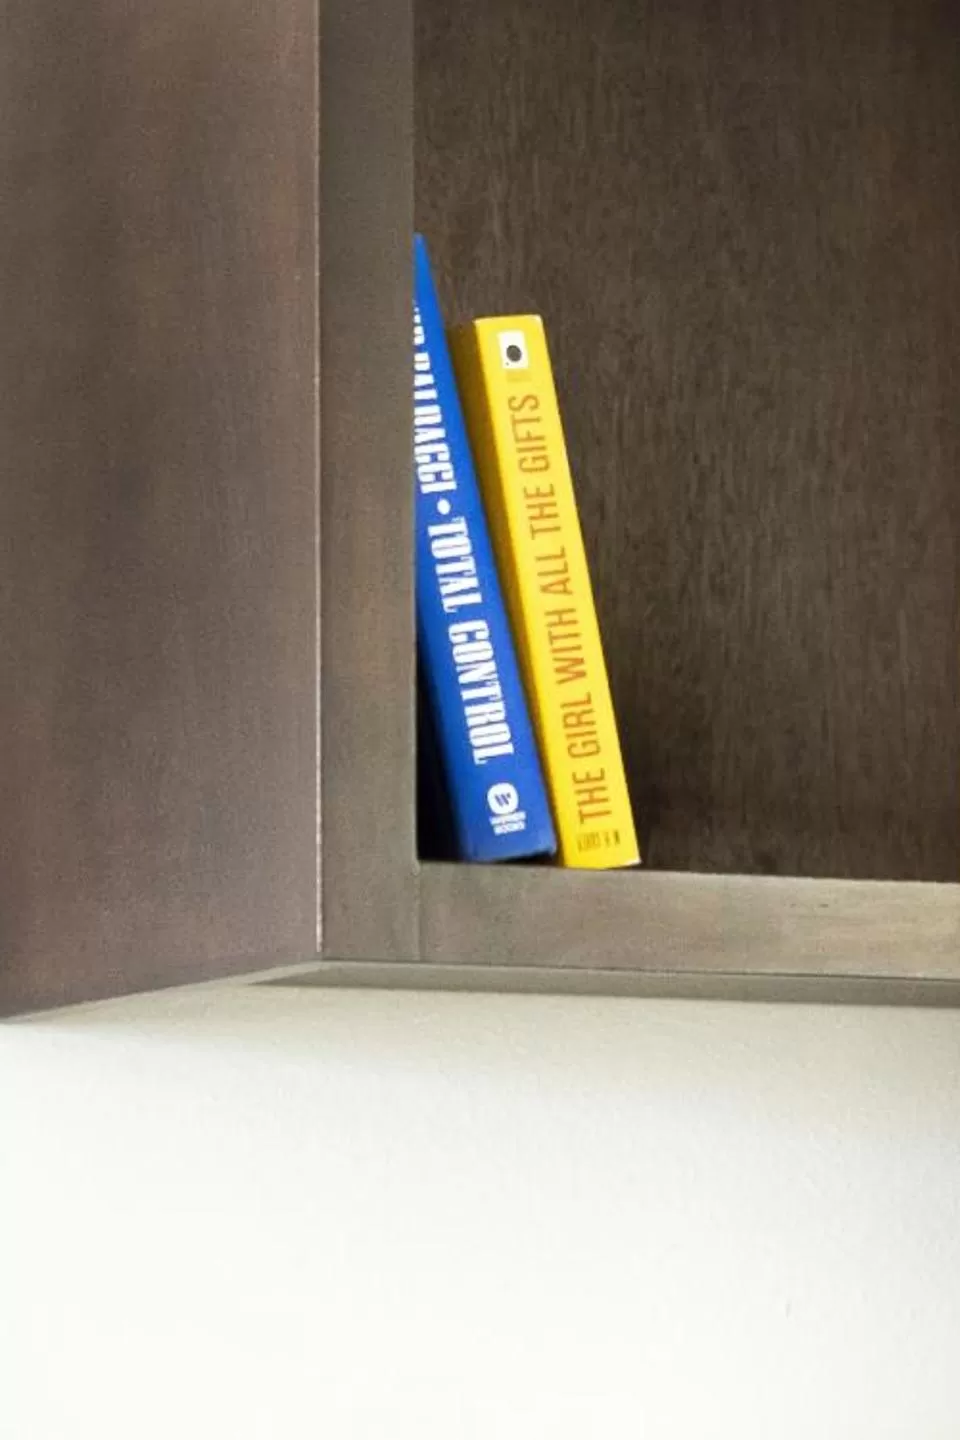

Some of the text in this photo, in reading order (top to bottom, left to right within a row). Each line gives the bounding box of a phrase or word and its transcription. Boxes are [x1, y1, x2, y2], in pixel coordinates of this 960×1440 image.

[508, 393, 551, 473] GIFTS
[523, 483, 562, 540] THE
[428, 516, 482, 613] TOTAL
[536, 547, 574, 596] ALL
[544, 607, 587, 685] WITH
[449, 620, 514, 765] CONTROL
[560, 691, 602, 760] GIRL
[572, 767, 612, 824] THE
